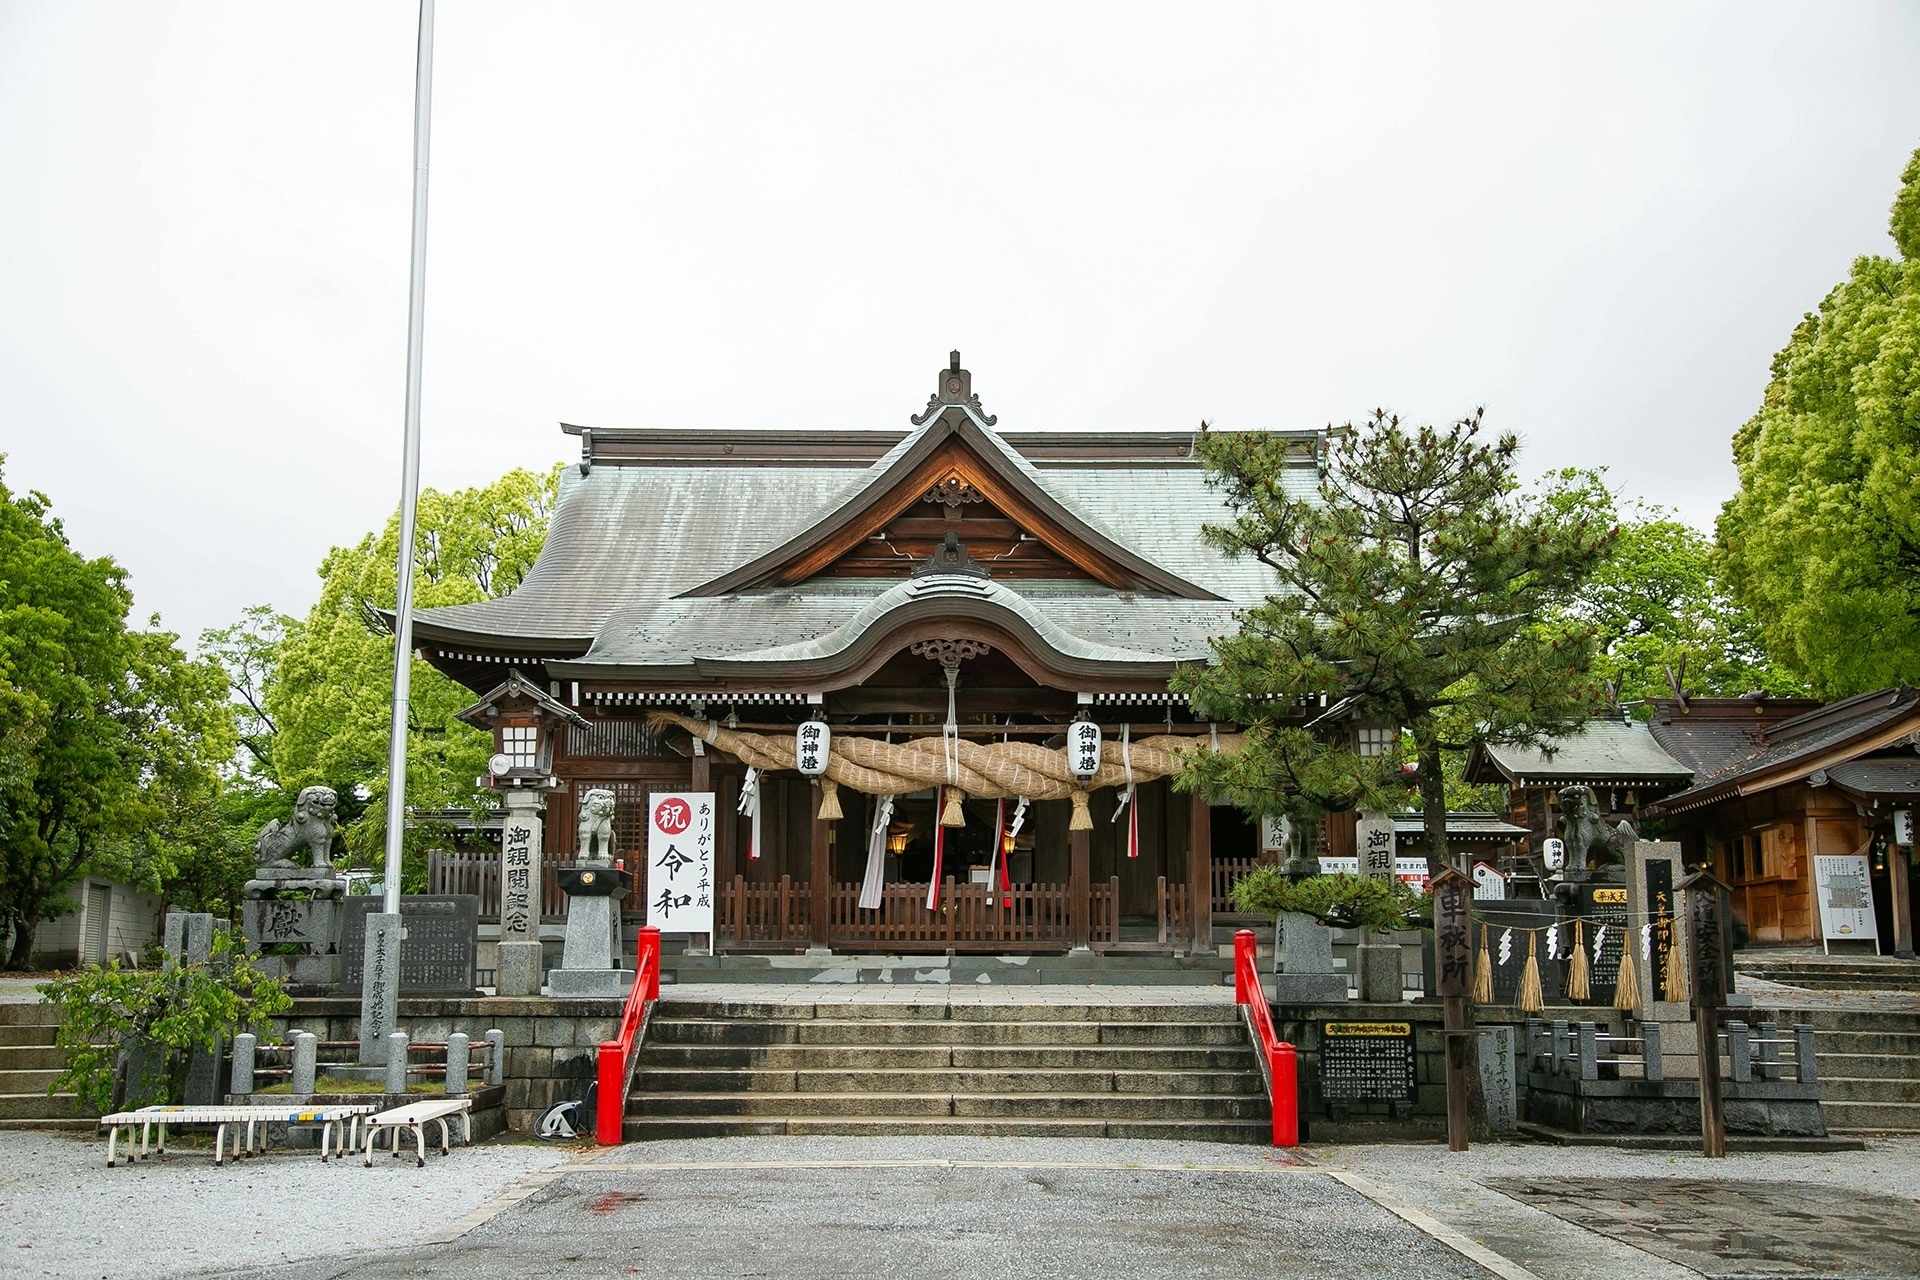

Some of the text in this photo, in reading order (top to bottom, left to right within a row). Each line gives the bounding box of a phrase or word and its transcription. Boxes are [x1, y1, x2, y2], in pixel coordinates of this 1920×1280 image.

[801, 725, 820, 770] 御神燈
[1078, 725, 1097, 771] 御神燈
[658, 804, 687, 829] 祝
[1270, 817, 1283, 846] 受付
[696, 803, 711, 908] ありがとう平成
[507, 826, 531, 933] 御親閲記念
[653, 844, 694, 919] 令和
